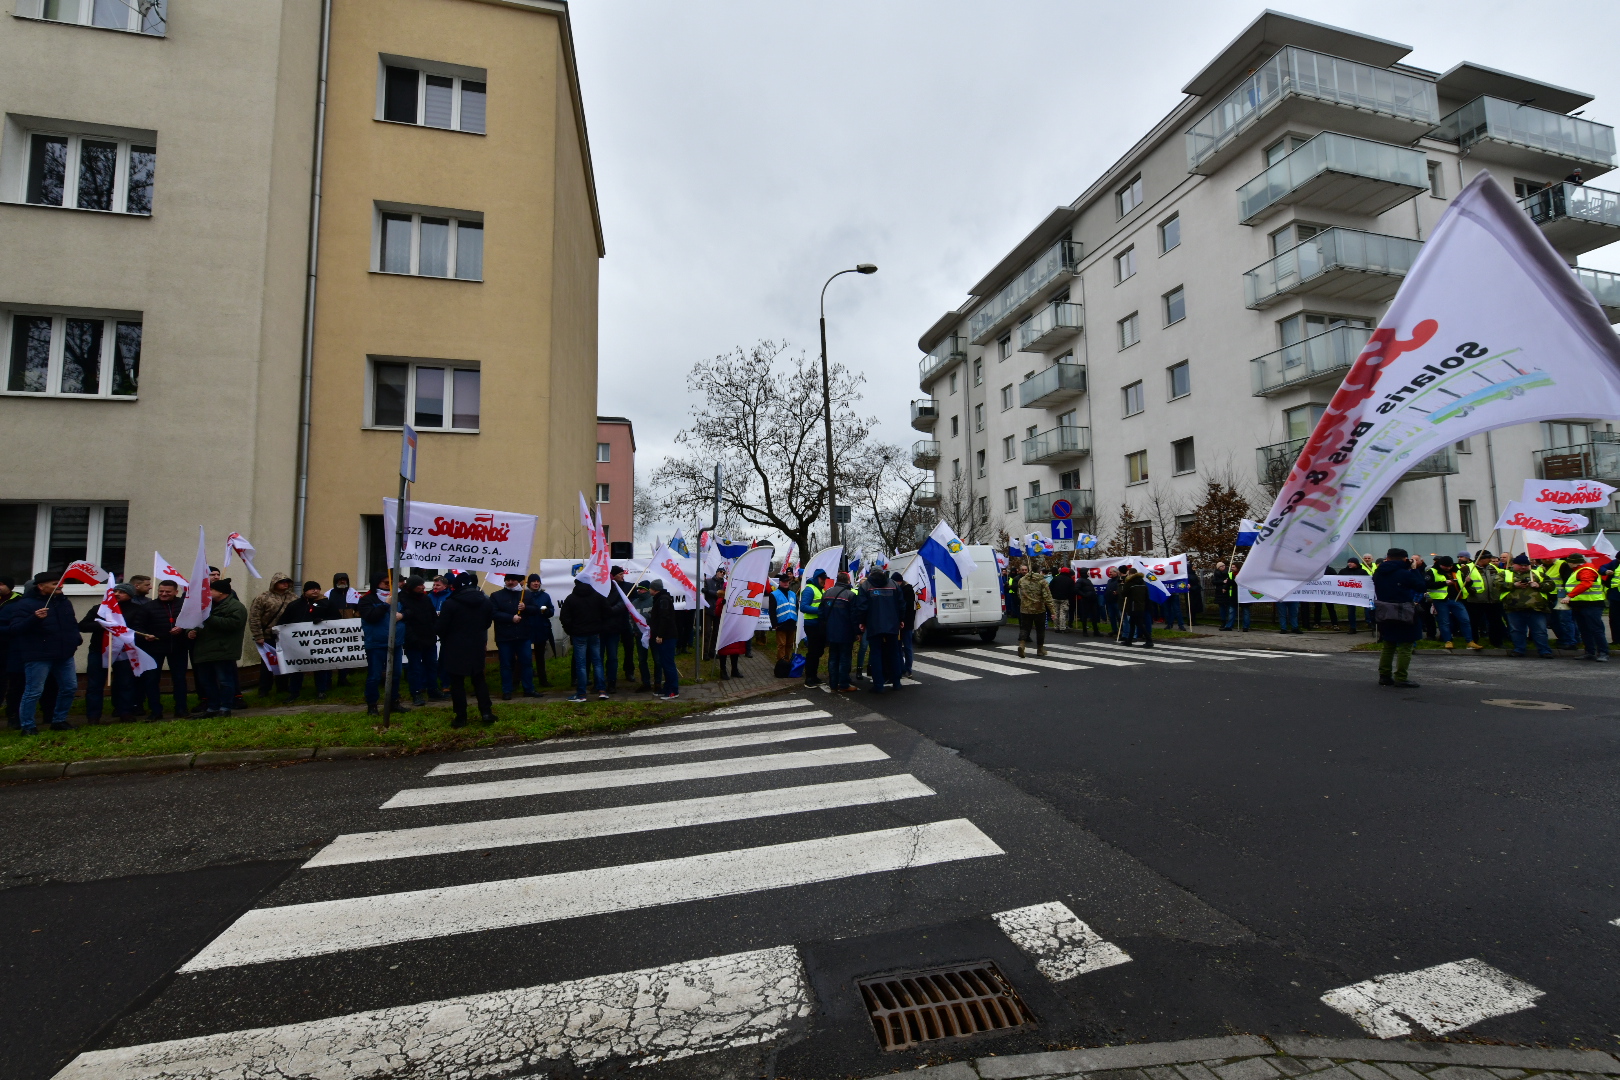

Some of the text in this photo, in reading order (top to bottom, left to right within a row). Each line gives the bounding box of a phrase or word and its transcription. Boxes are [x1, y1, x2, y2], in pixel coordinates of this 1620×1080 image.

[415, 541, 502, 556] PKP CARGO S.A.
[400, 552, 520, 568] Zachodni Zakład Spółki
[291, 627, 337, 638] ZWIĄZKI
[313, 636, 359, 645] OBRONIE
[310, 646, 345, 655] PRACY
